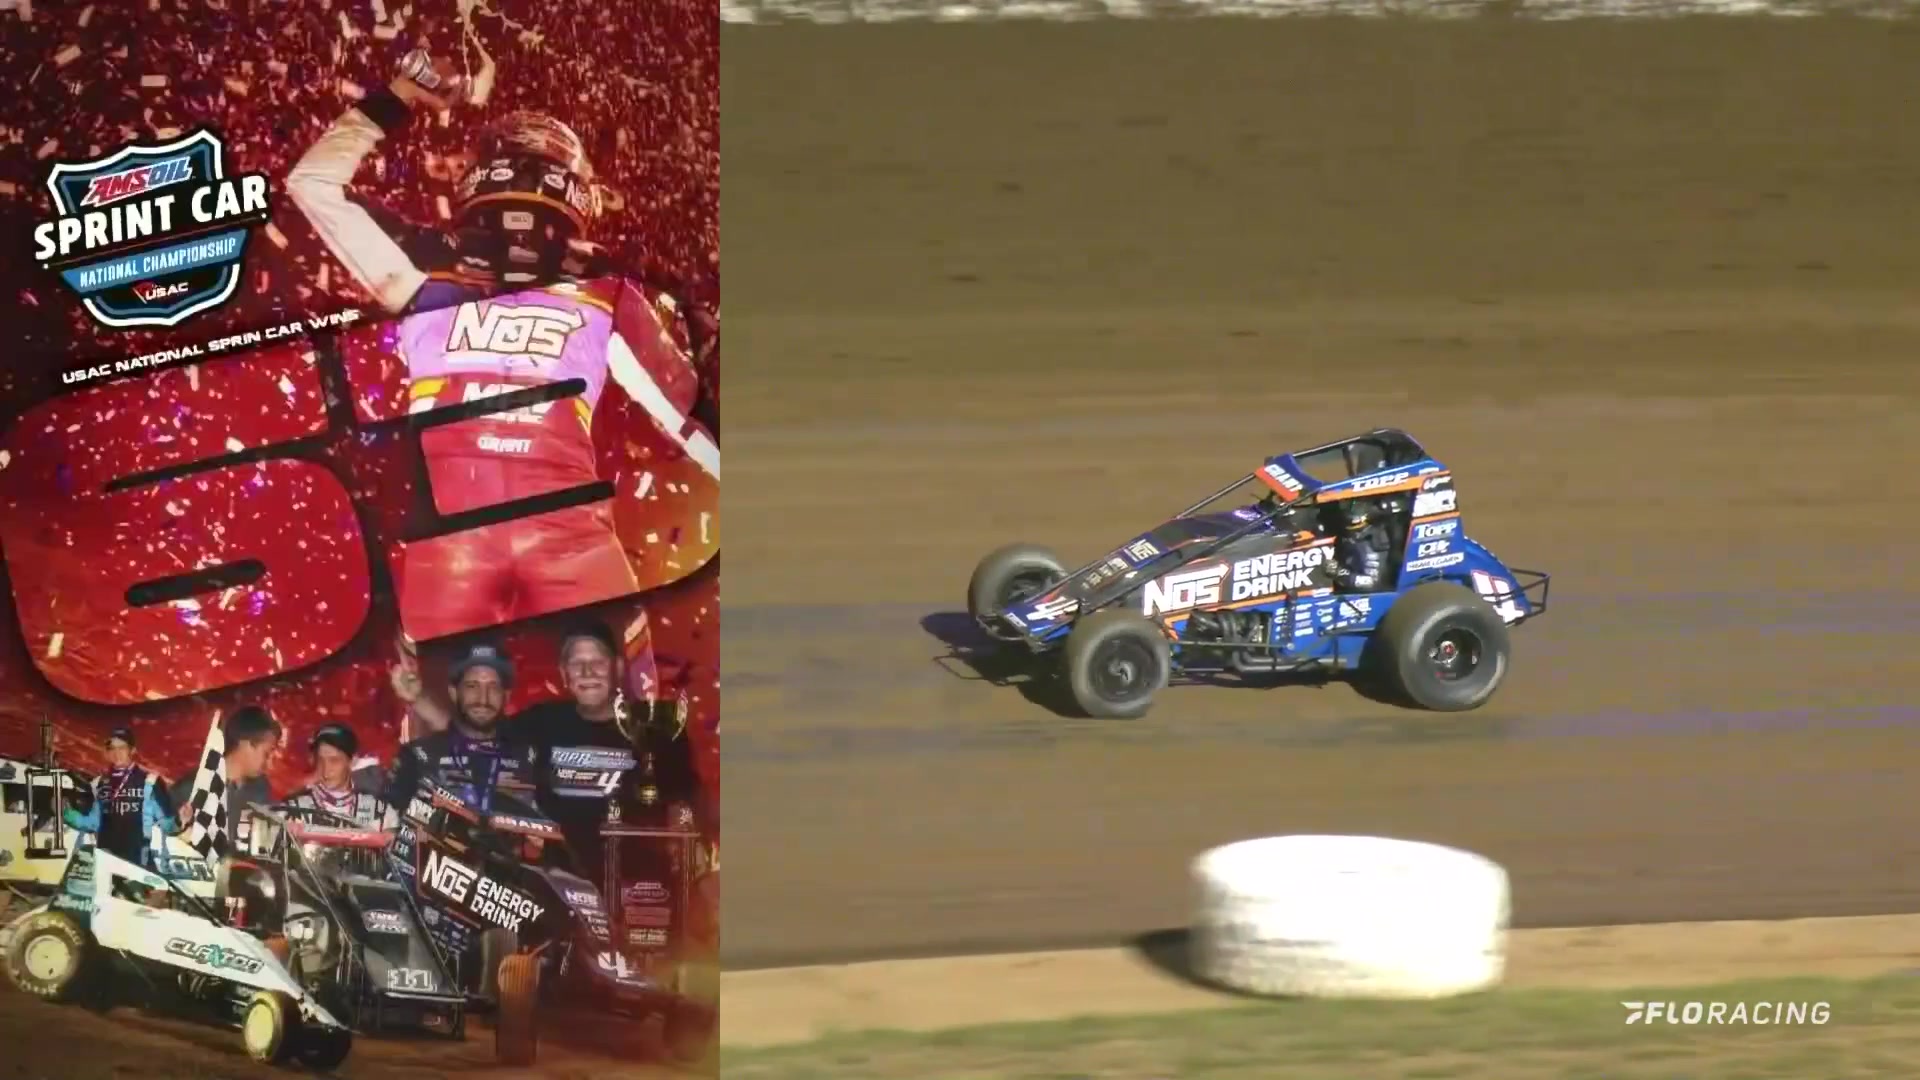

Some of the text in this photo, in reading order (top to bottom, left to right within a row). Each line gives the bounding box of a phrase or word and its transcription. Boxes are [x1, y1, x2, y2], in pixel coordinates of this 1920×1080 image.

[80, 157, 193, 207] AMSOIL
[34, 175, 268, 260] SPRINT CAR
[80, 237, 237, 288] NATIONAL CHAMPIONSHIP
[145, 282, 189, 300] USAC
[62, 309, 361, 384] USAC NATIONAL SPRIN CAR WINS
[446, 302, 585, 359] NOS
[477, 435, 532, 453] GRANT
[1232, 567, 1315, 601] DRINK
[1233, 546, 1336, 581] ENERGY
[1143, 562, 1231, 616] NOS
[423, 850, 478, 904] NOS
[477, 876, 545, 922] ENERGY
[470, 894, 523, 933] DRINK
